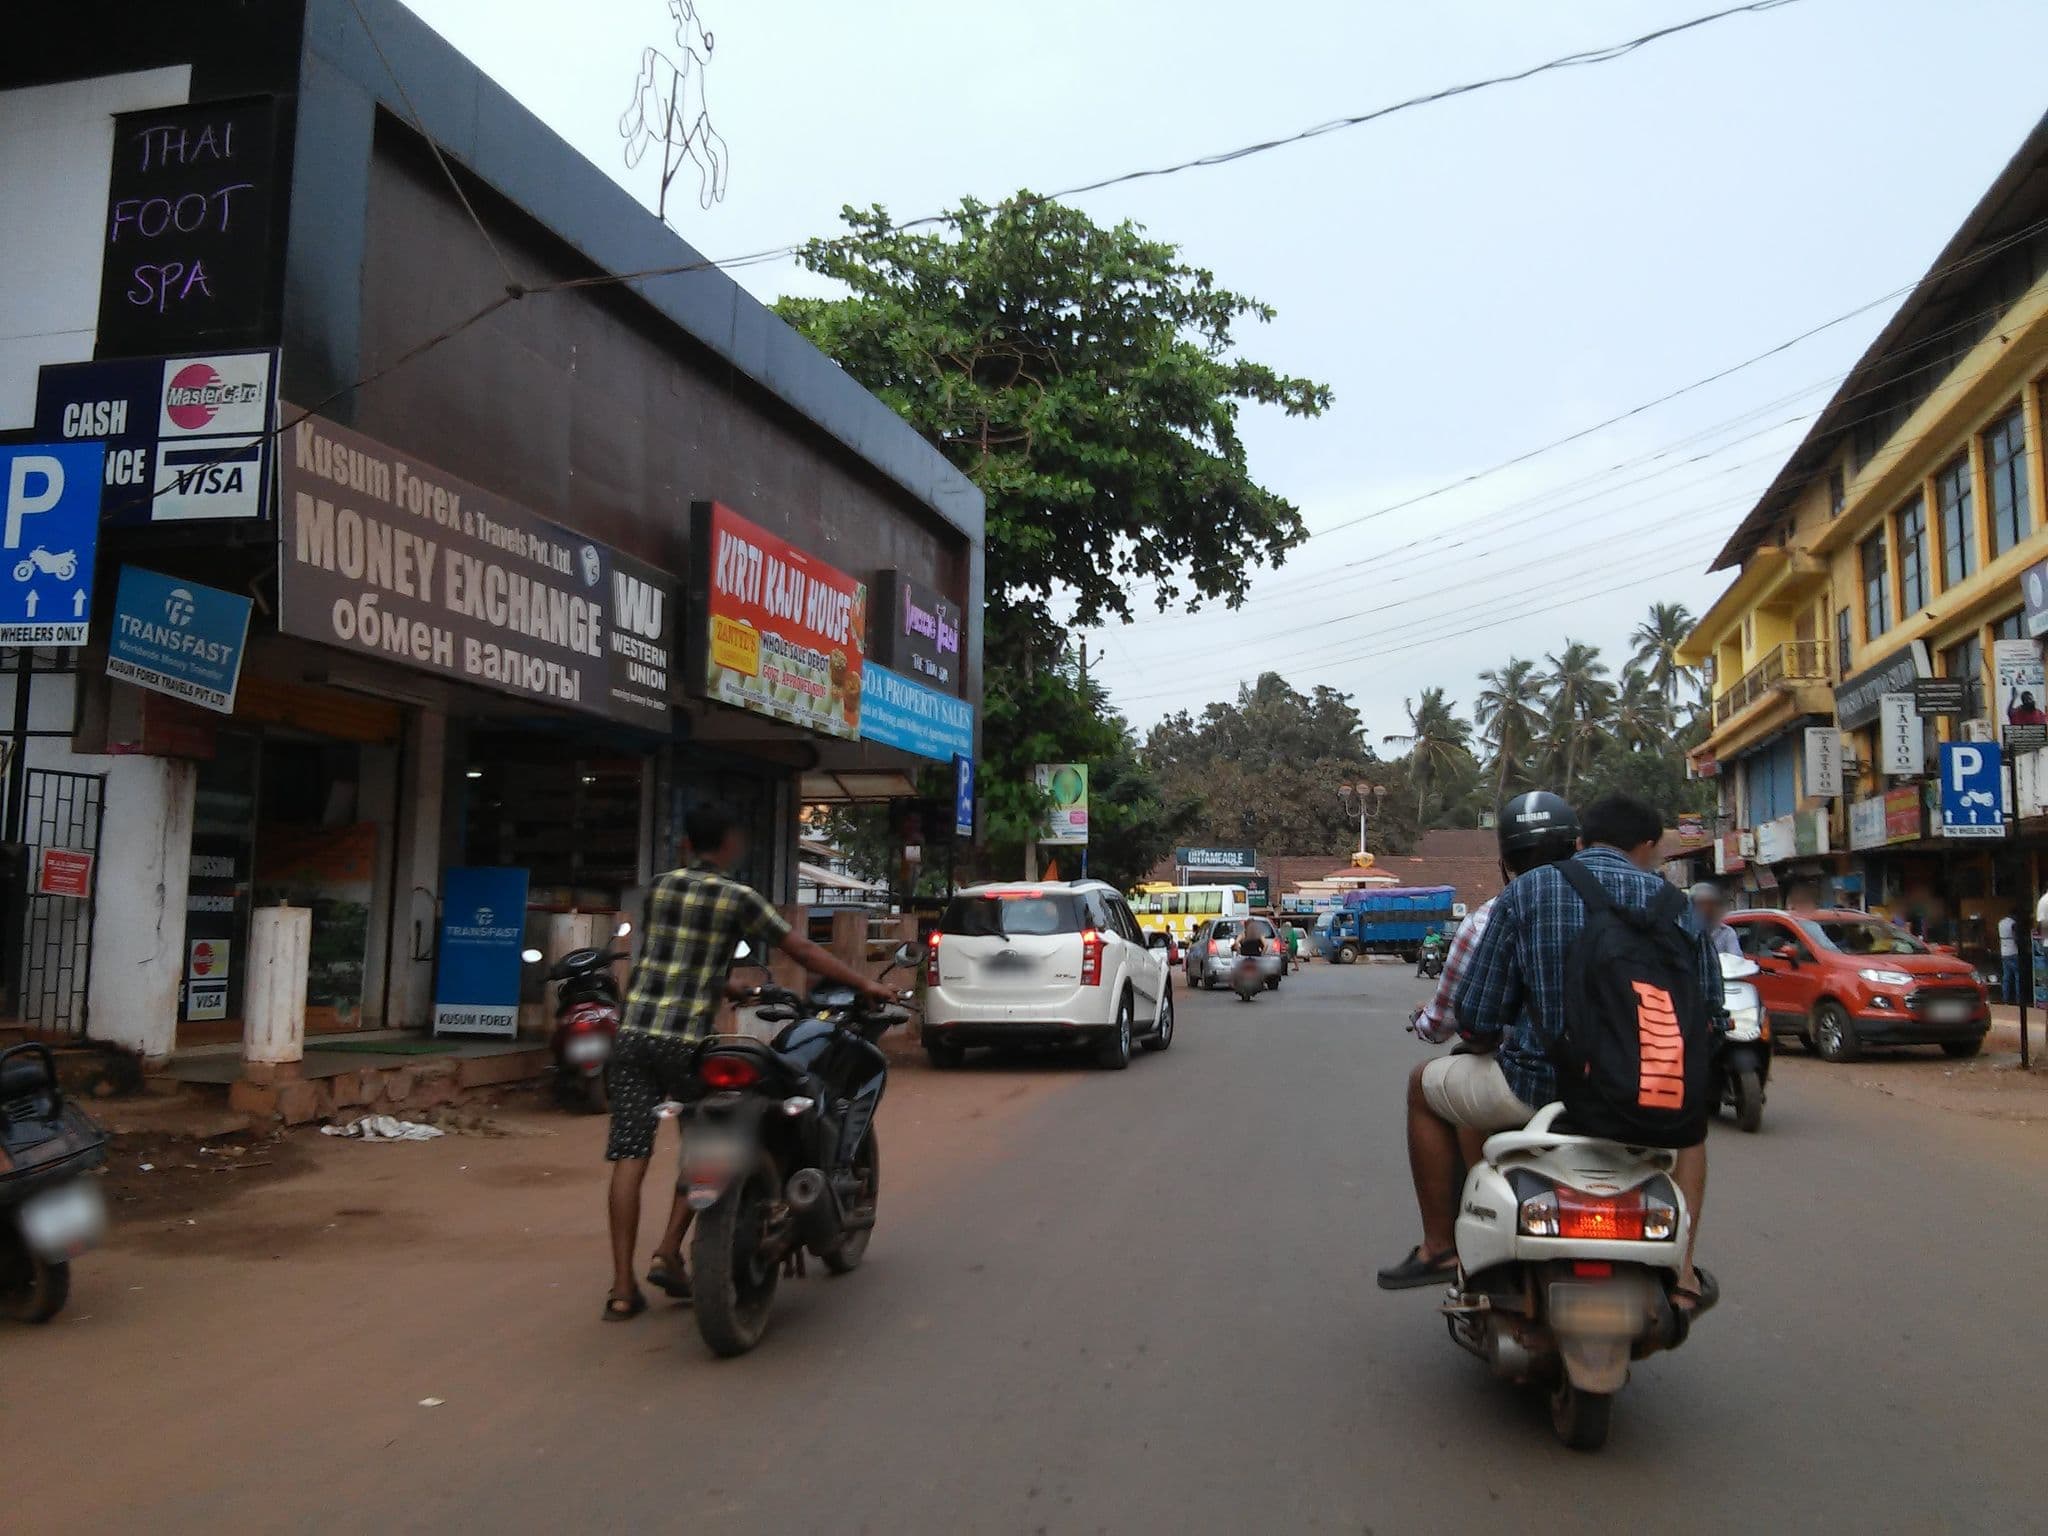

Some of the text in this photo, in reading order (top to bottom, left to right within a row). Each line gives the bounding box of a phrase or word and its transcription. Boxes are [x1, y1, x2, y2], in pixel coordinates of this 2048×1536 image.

[135, 122, 234, 171] THAI
[112, 184, 254, 242] FOOT
[128, 260, 212, 313] SPA
[168, 381, 264, 406] MasterCard
[63, 400, 128, 438] CASH
[3, 456, 65, 549] P
[176, 467, 244, 496] VISA
[296, 420, 391, 502] Kusum
[396, 463, 461, 530] Forex
[477, 511, 529, 557] Travels
[296, 492, 603, 658] MONEY EXCHANGE
[715, 529, 762, 605] KIRTI
[763, 554, 806, 625] KAJU
[807, 578, 851, 645] HOUSE
[1, 623, 83, 643] WHEELERS ONLY
[120, 614, 234, 664] TRANSFAST
[611, 632, 667, 668] WESTERN
[464, 637, 581, 702] валюты
[628, 662, 666, 691] UNION
[886, 677, 940, 720] PROPERTY
[1896, 704, 1911, 765] TATTOO
[1951, 747, 1983, 791] P
[196, 995, 222, 1009] VISA
[439, 1013, 514, 1027] KUSUM FOREX
